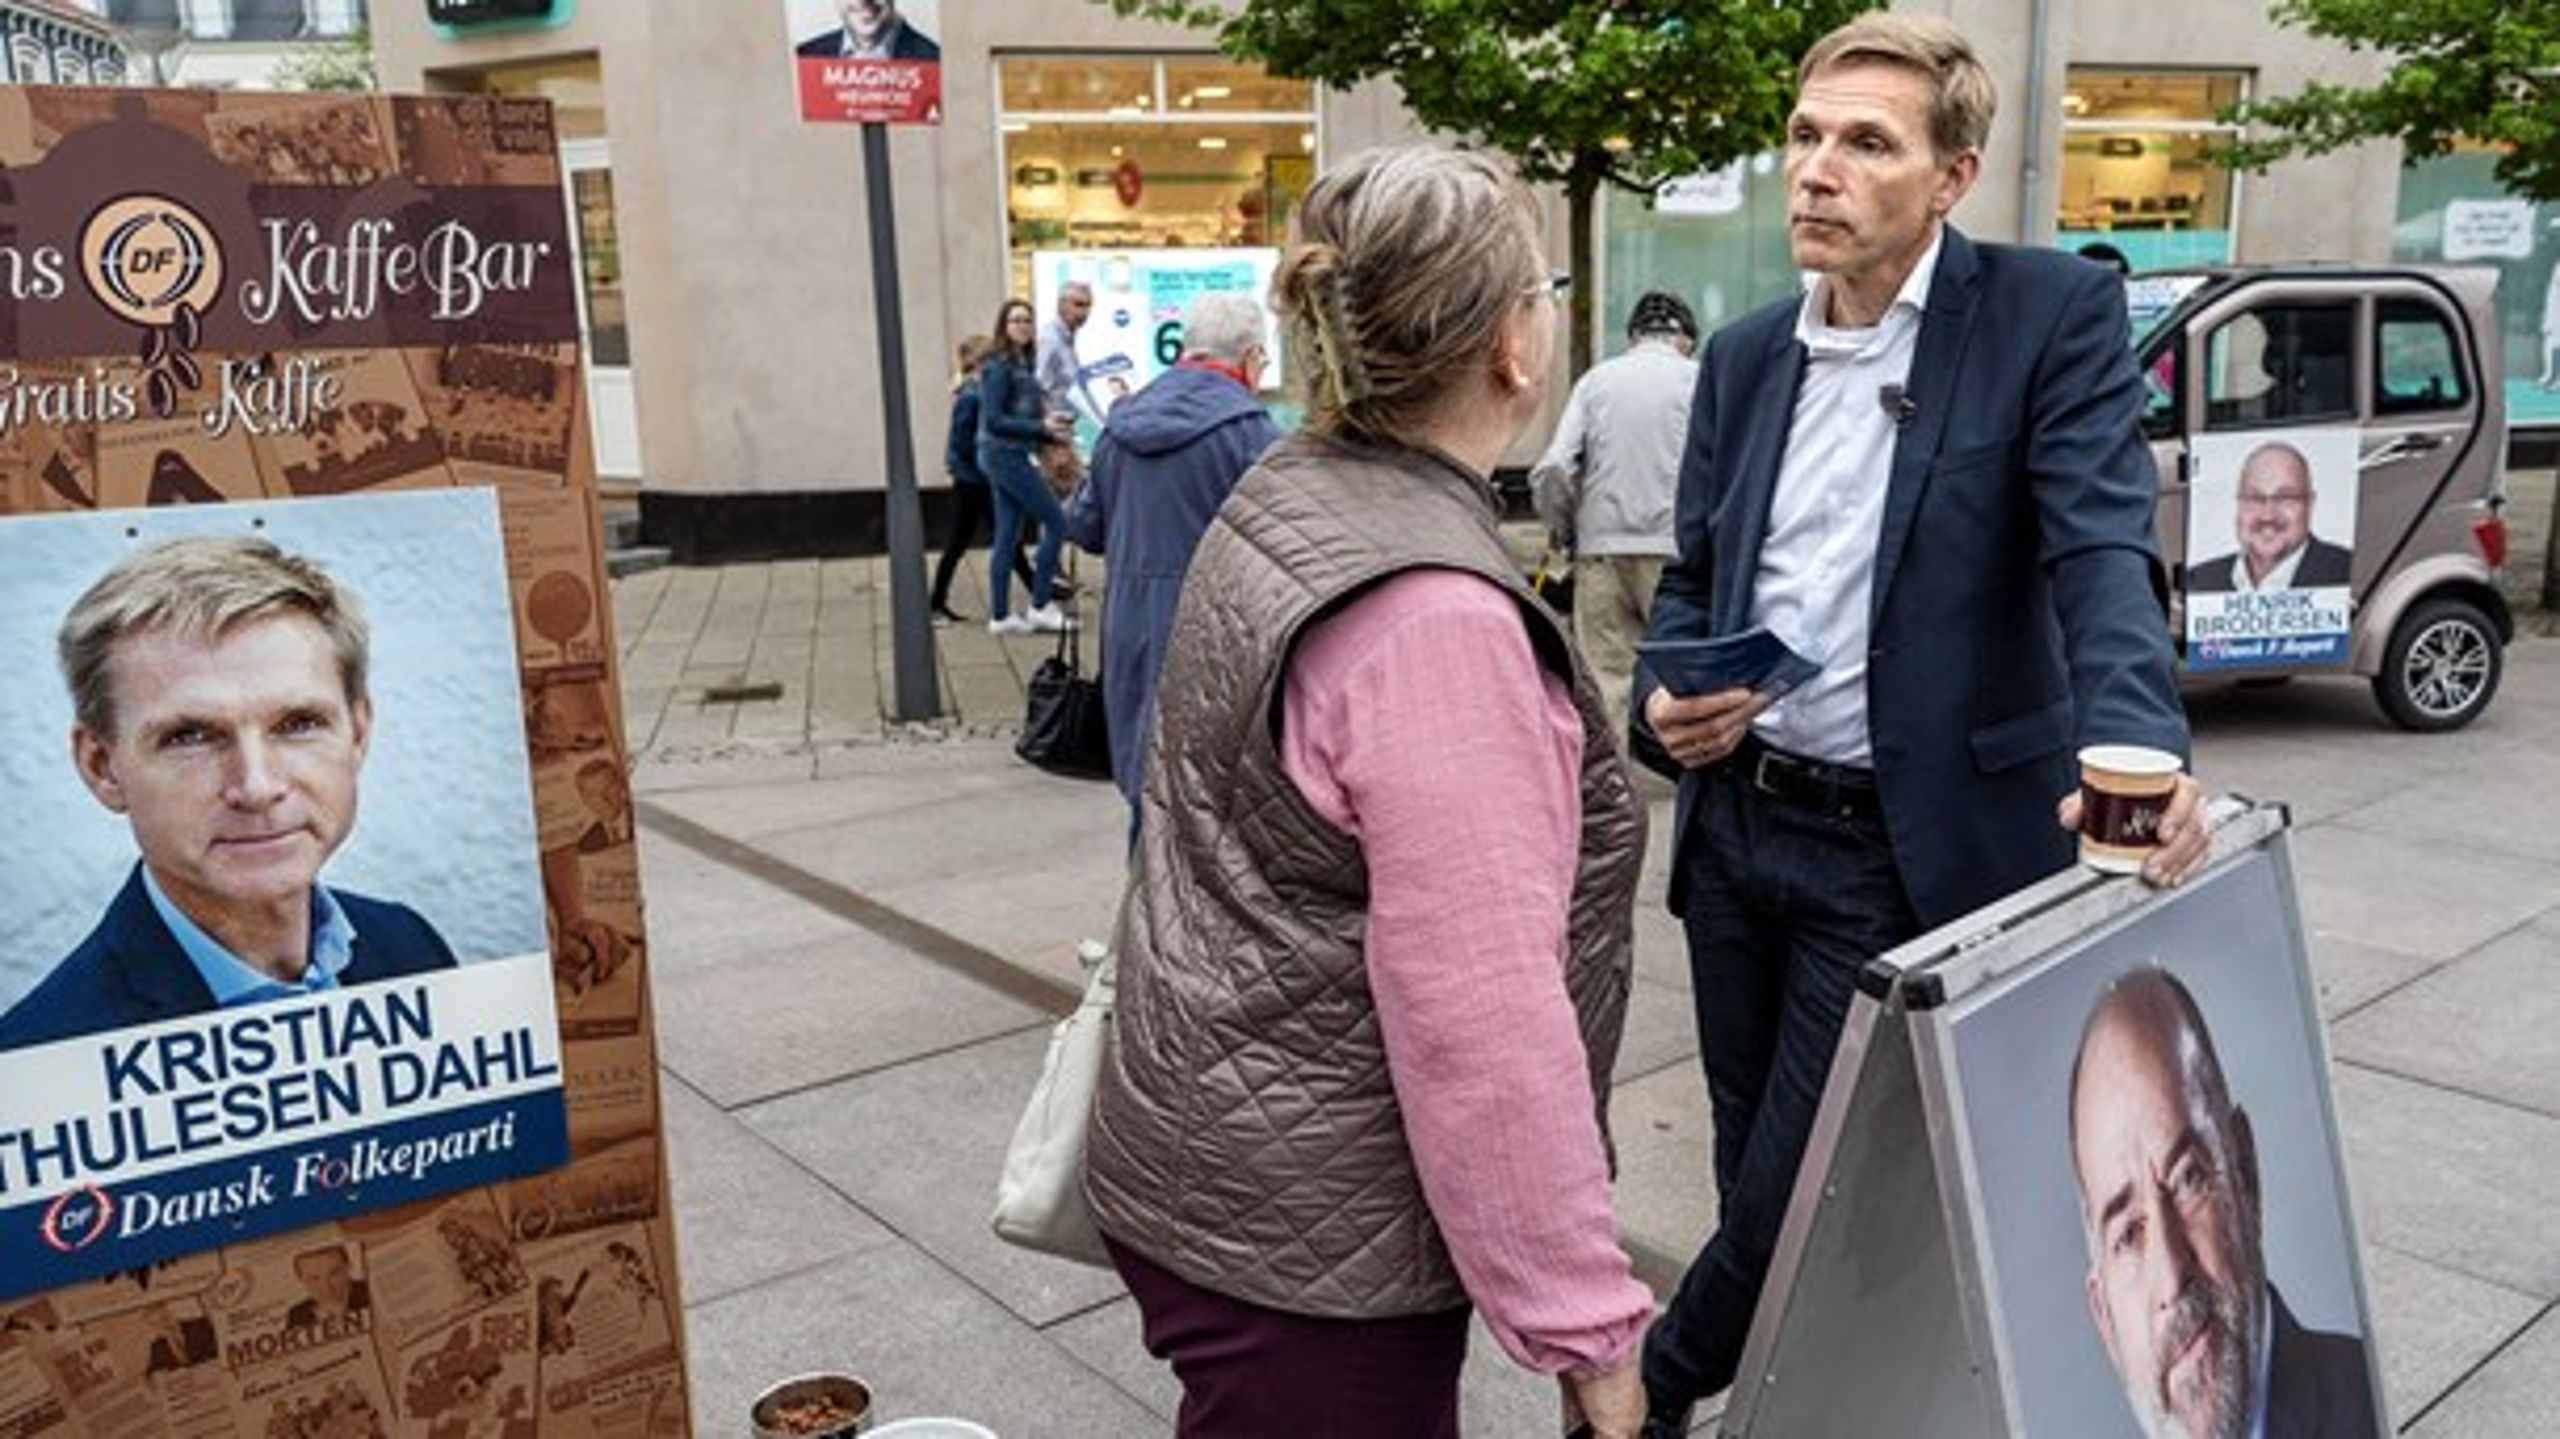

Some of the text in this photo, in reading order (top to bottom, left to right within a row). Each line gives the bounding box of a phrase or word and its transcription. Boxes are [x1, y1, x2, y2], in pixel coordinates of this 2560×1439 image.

[822, 66, 922, 89] MAGNUS
[130, 249, 176, 273] DF
[203, 359, 342, 437] Kaffe
[2194, 609, 2342, 635] BRODERSEN
[2223, 591, 2313, 614] HENRIK
[103, 985, 433, 1103] KRISTIAN
[0, 1028, 558, 1193] THULESEN DAHL
[118, 1166, 273, 1239] Dansk
[292, 1111, 517, 1198] Folkeparti
